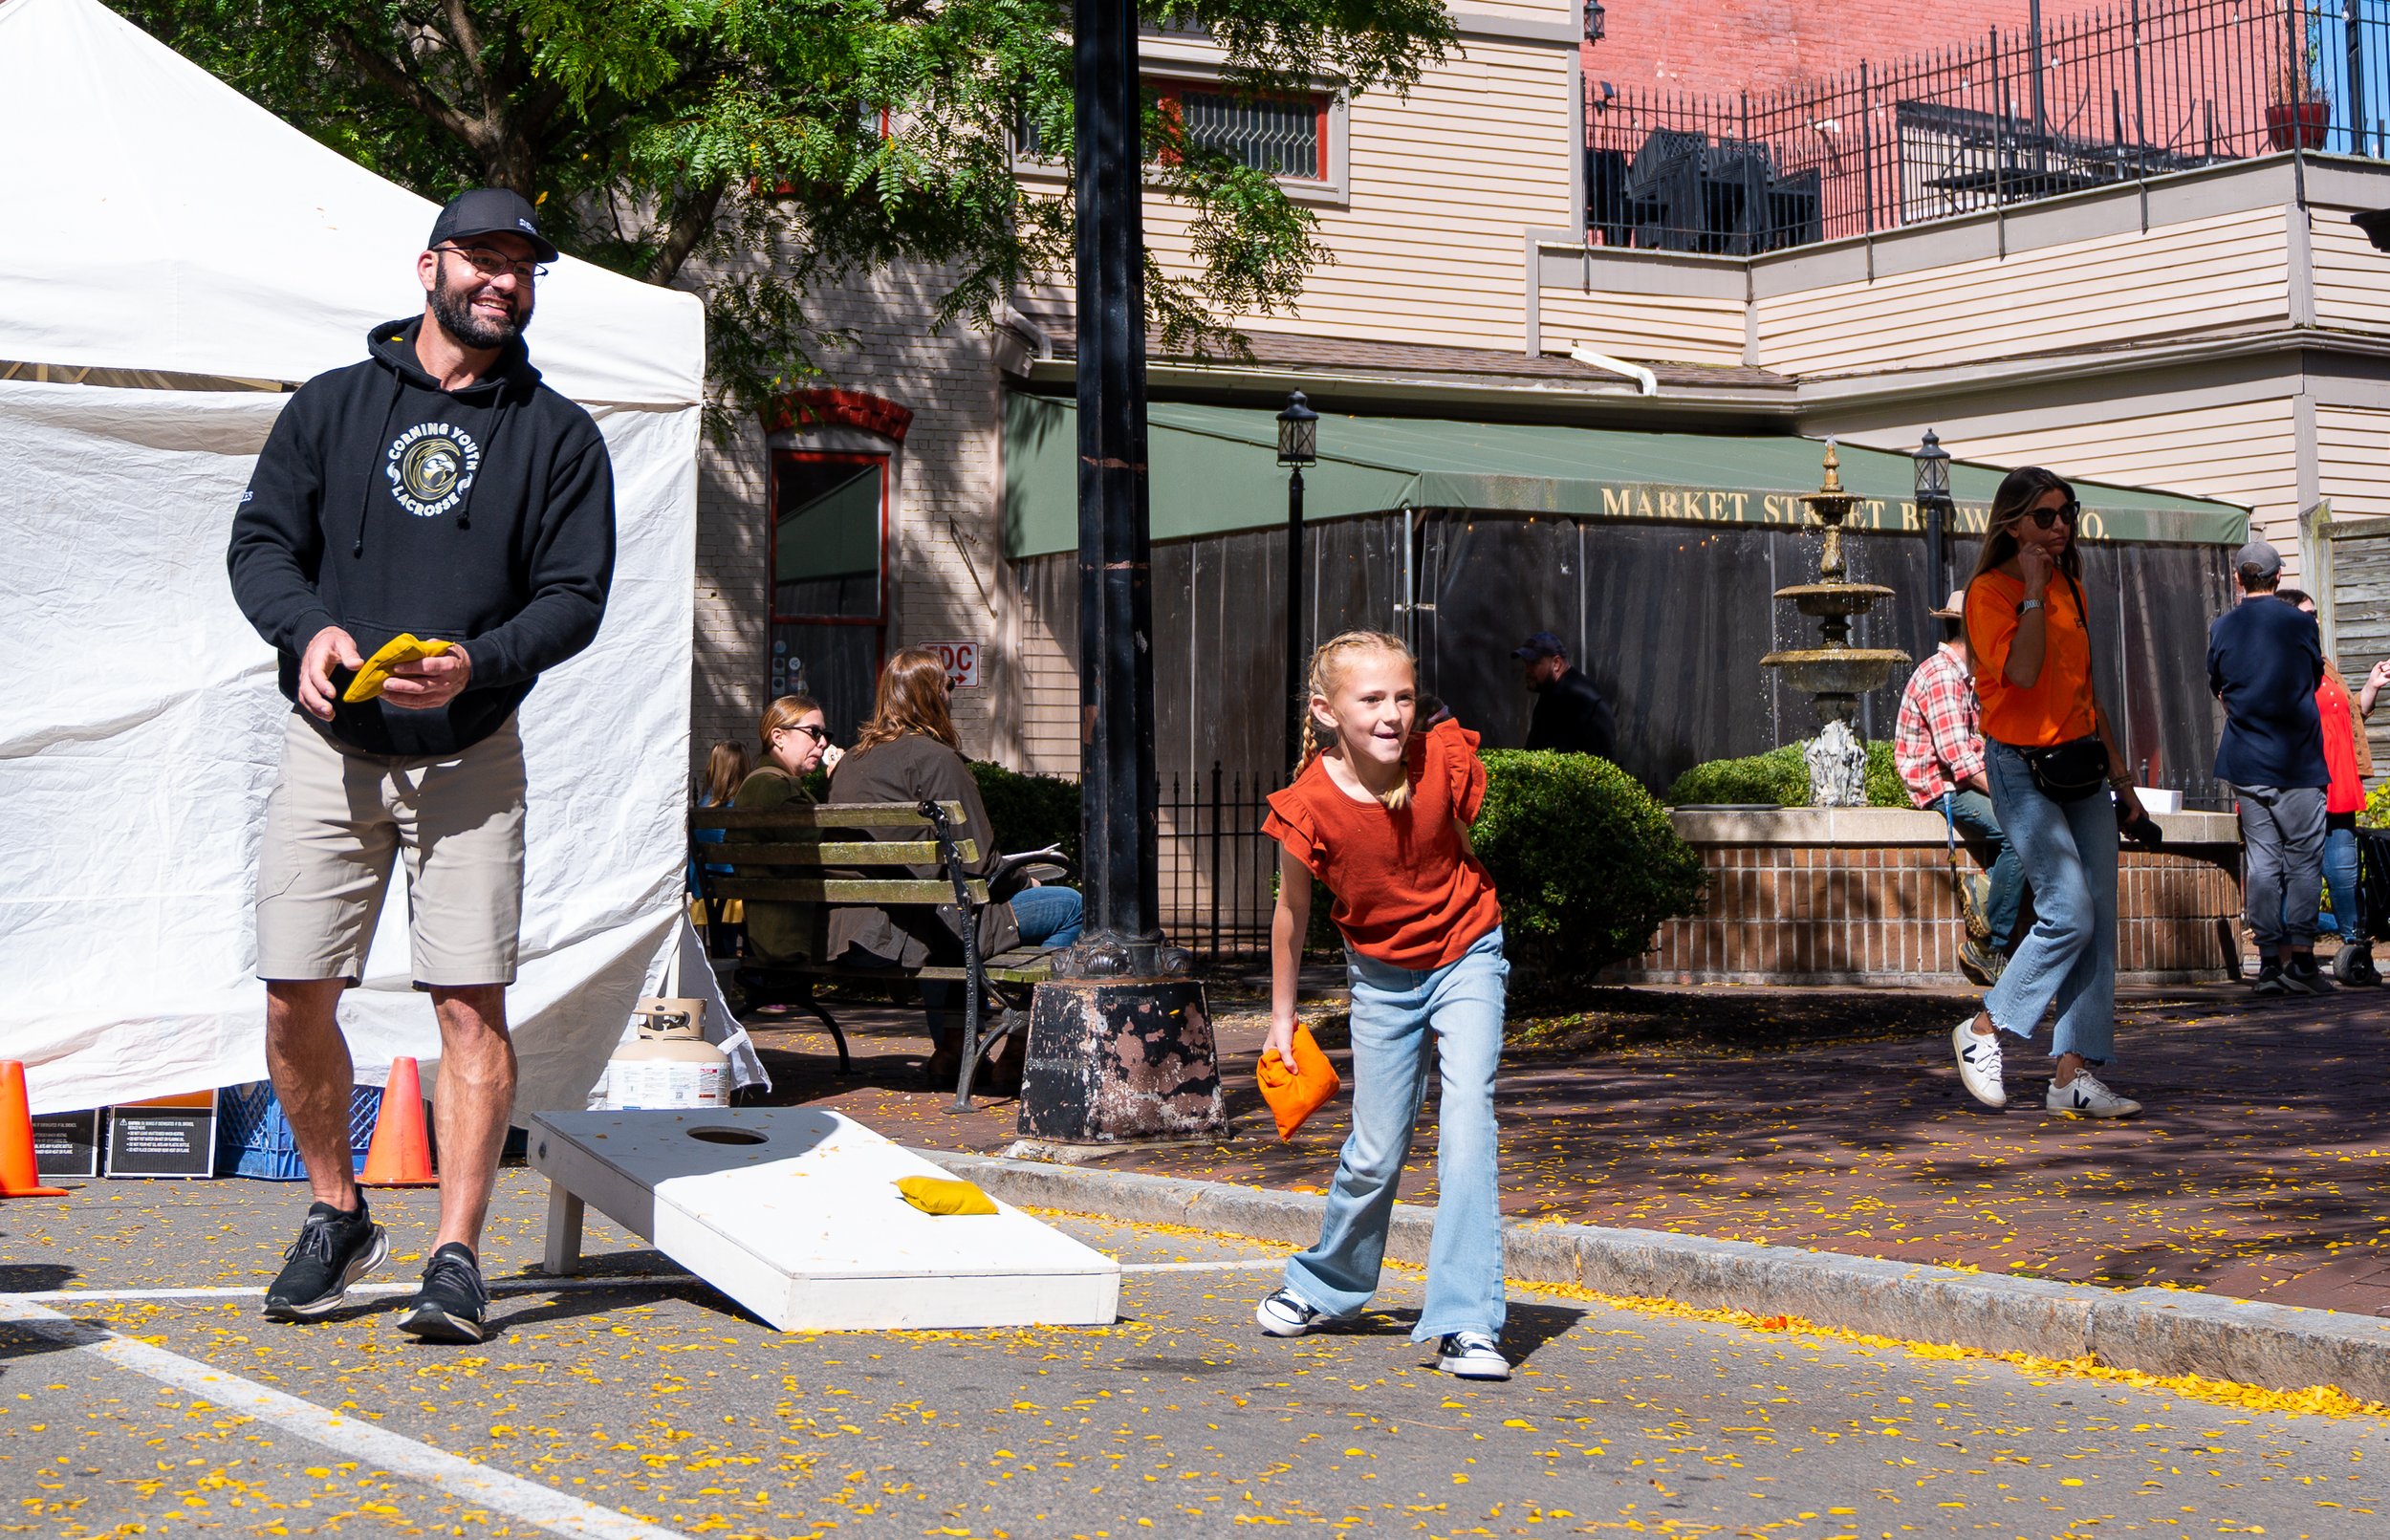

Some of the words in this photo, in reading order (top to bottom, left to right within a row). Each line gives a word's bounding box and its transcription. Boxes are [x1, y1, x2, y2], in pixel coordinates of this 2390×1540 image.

[388, 423, 449, 460] CORNING
[450, 426, 480, 470] YOUTH
[391, 485, 460, 517] LACROSSE
[1600, 488, 1749, 523] MARKET
[1763, 494, 1885, 530] STRET
[2076, 511, 2110, 539] O.
[924, 645, 972, 671] DC
